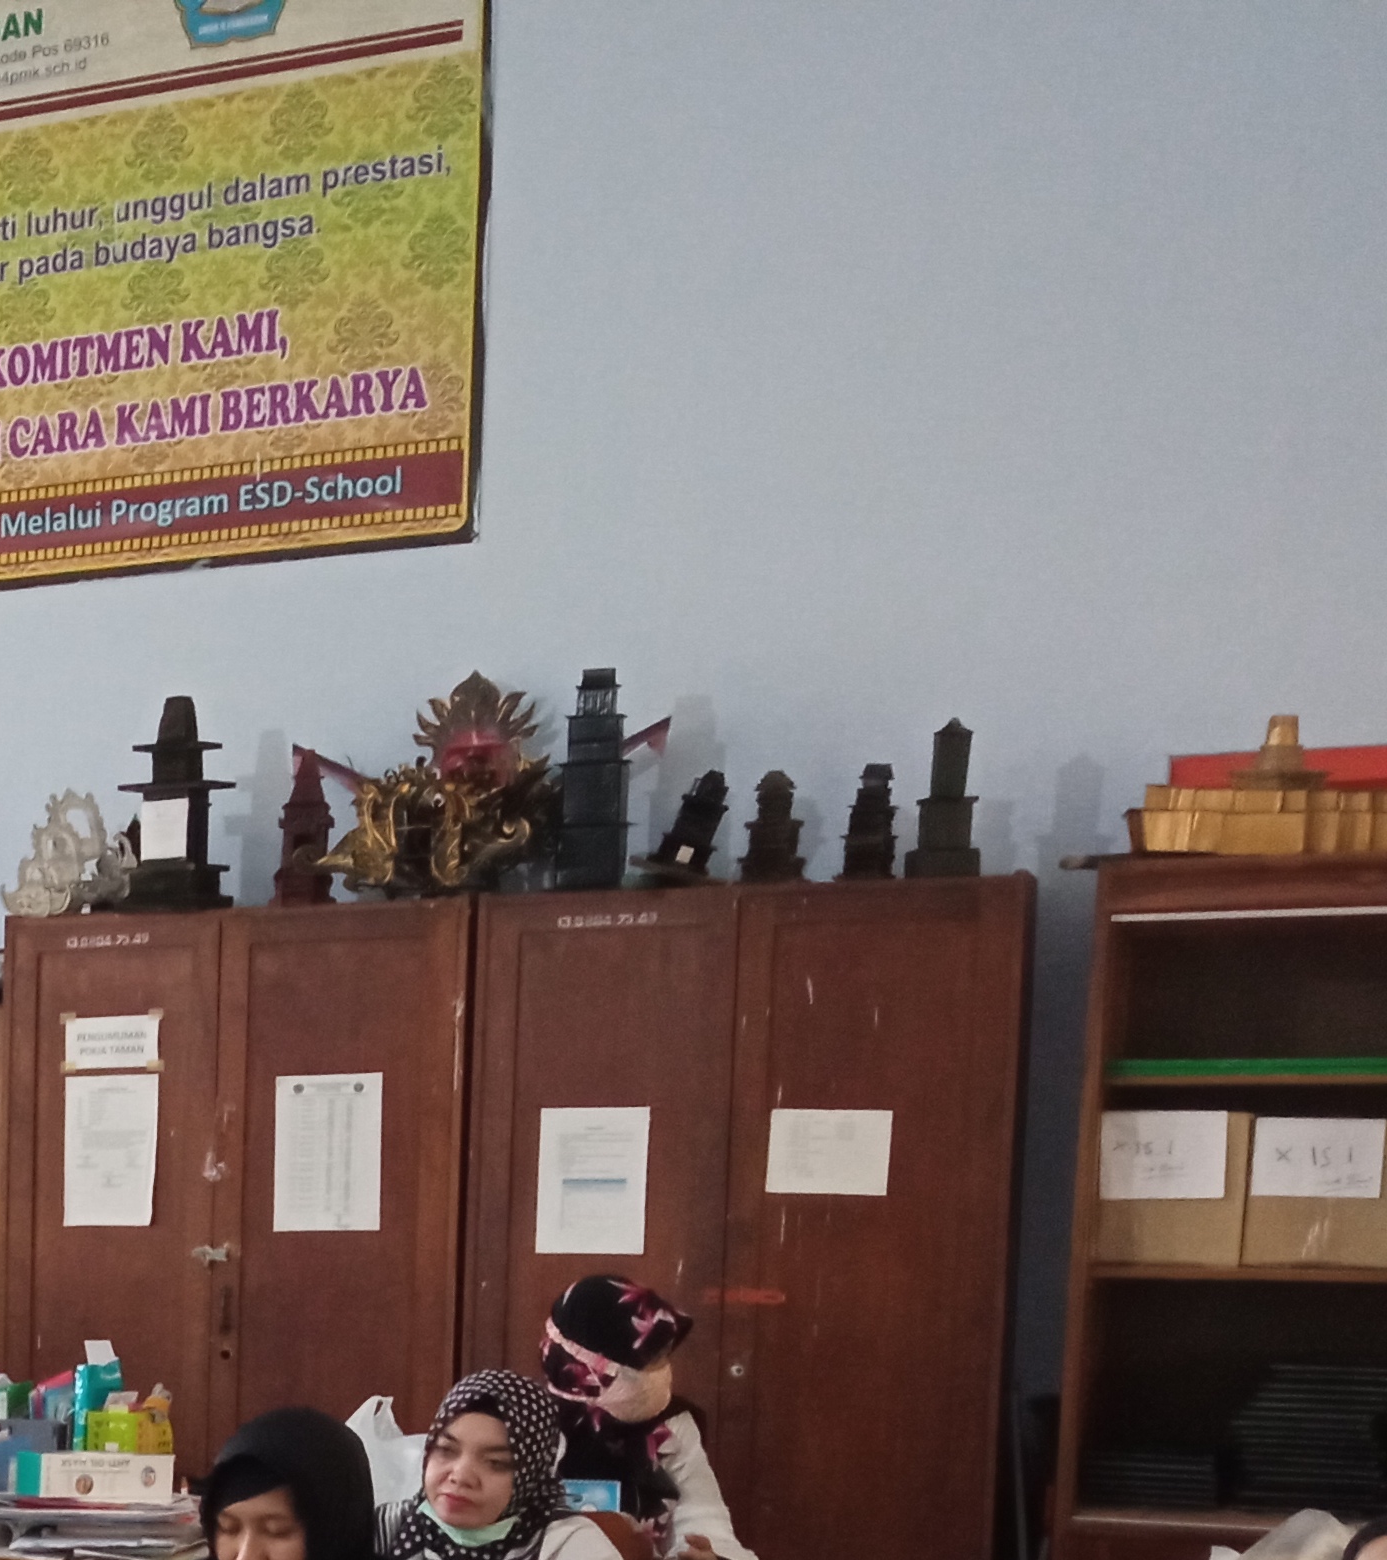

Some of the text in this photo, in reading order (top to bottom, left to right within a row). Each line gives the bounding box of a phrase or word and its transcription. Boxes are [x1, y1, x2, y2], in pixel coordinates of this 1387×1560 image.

[32, 44, 59, 58] Pos
[63, 32, 109, 52] 69316
[26, 207, 103, 238] luhur,
[116, 182, 212, 224] unggul
[223, 173, 311, 206] dalam
[321, 144, 451, 198] prestasi,
[18, 247, 84, 285] pada
[94, 232, 197, 267] budaya
[207, 213, 321, 249] bangsa.
[180, 308, 288, 360] KAMI,
[8, 406, 107, 459] CARA
[115, 393, 212, 446] KAMI
[219, 366, 428, 433] BERKARYA
[0, 501, 102, 538] Melalui
[110, 492, 228, 527] Program
[239, 465, 402, 511] ESD-School
